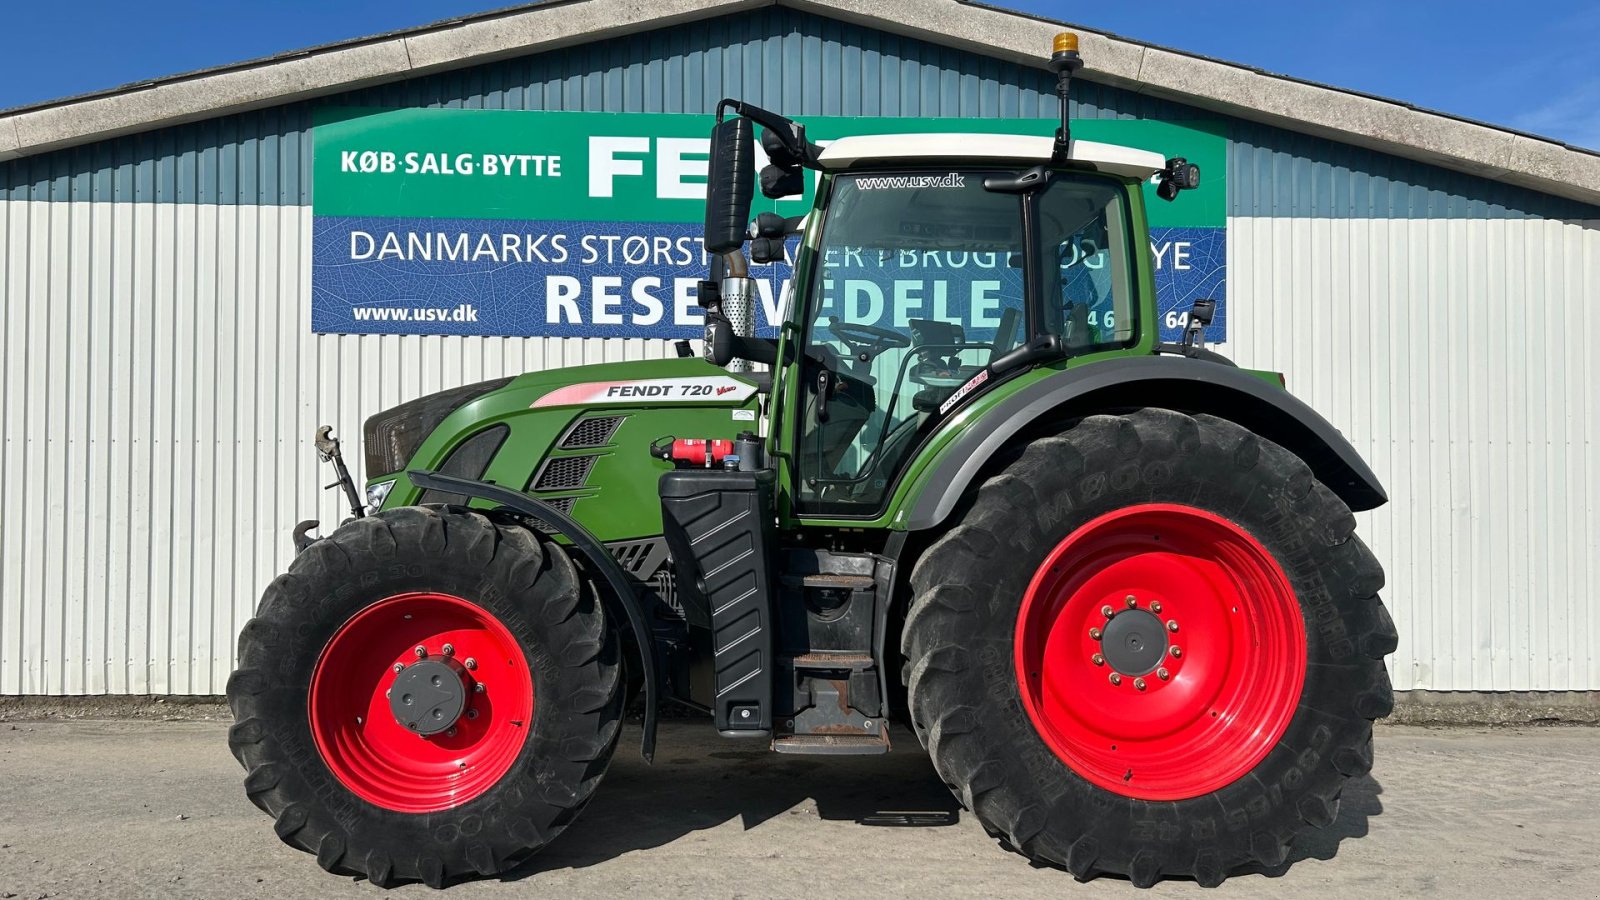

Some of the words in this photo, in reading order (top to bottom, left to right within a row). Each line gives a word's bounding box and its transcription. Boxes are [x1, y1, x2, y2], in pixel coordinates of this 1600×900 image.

[855, 172, 965, 190] www.usv.dk
[351, 231, 568, 263] DANMARKS
[582, 235, 707, 266] STØRST
[1151, 241, 1191, 270] YE
[353, 304, 478, 323] www.usv.dk
[607, 385, 673, 397] FENDT
[681, 385, 713, 396] 720
